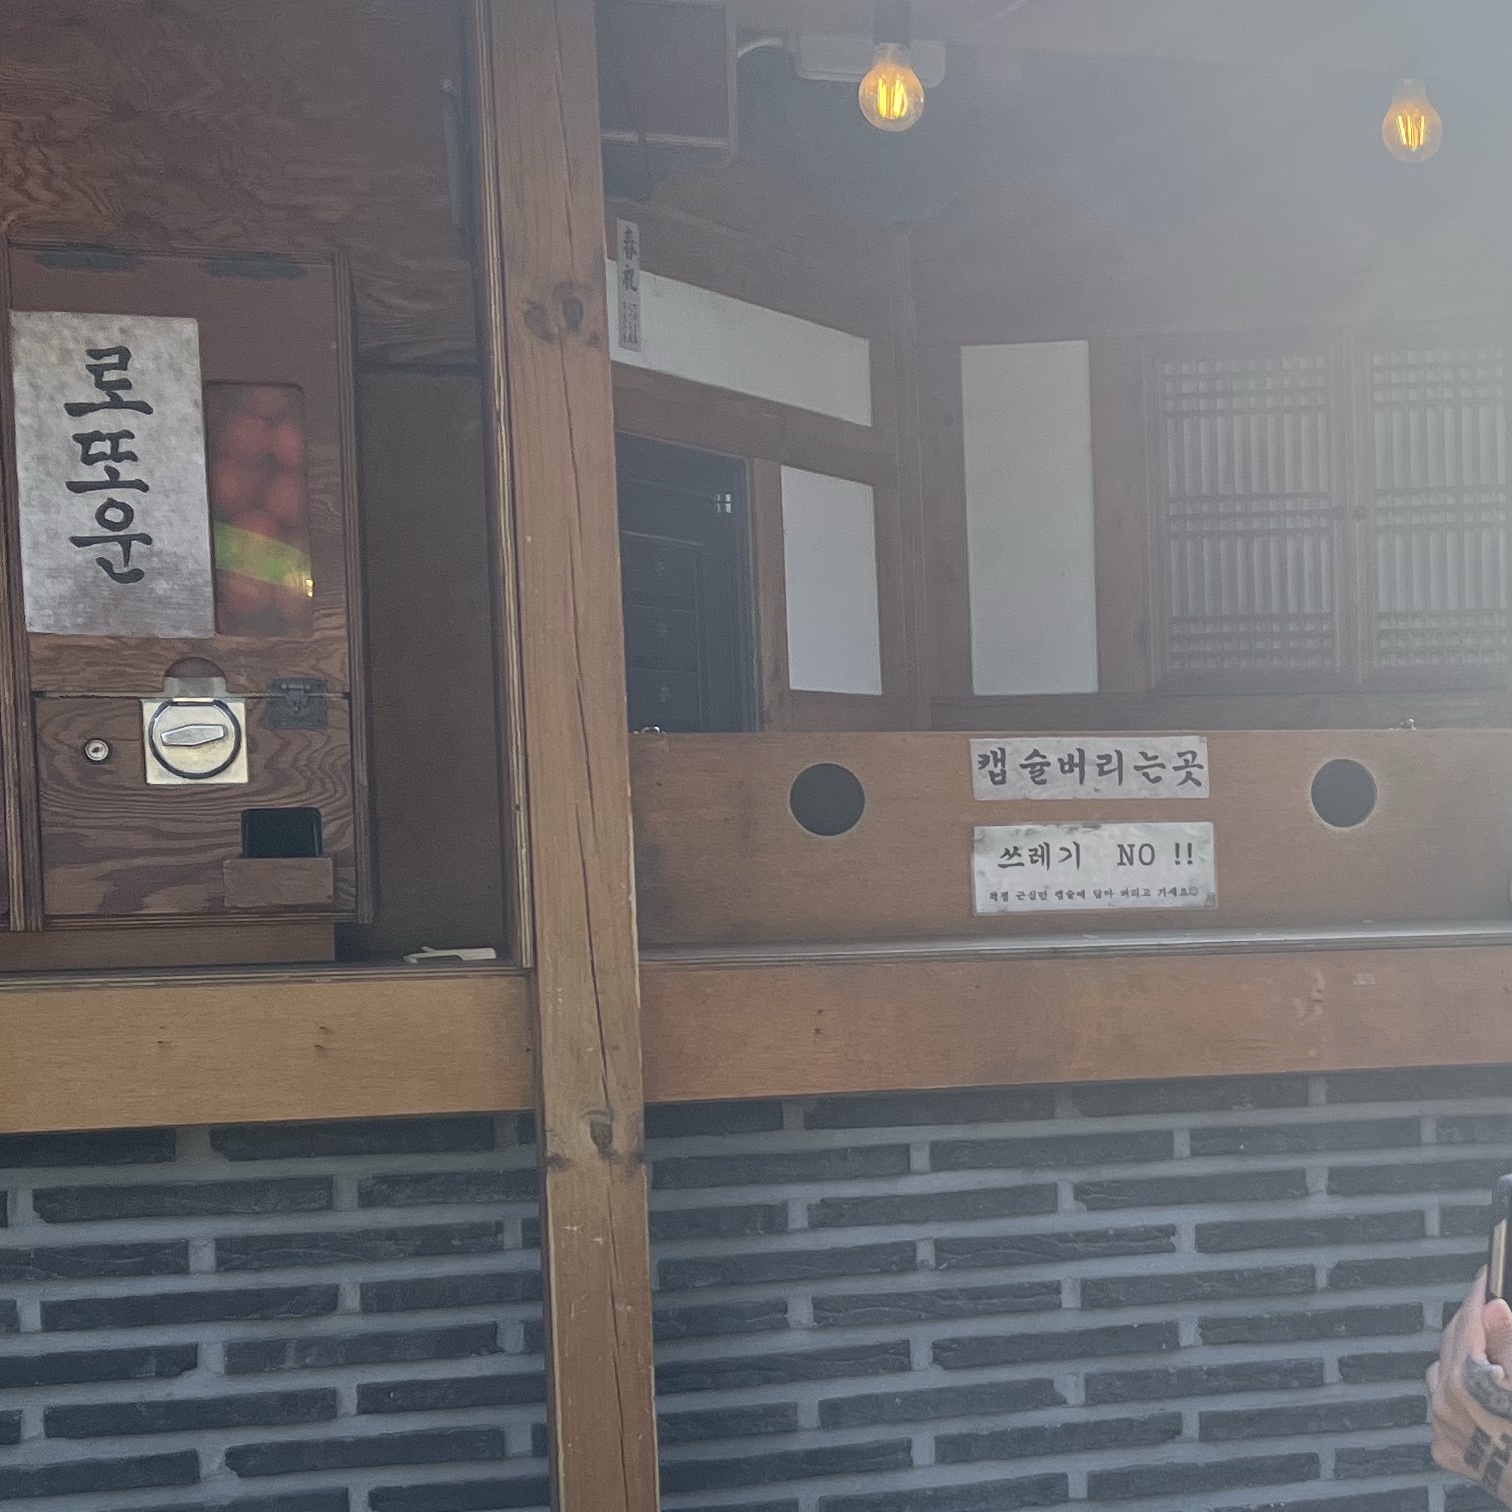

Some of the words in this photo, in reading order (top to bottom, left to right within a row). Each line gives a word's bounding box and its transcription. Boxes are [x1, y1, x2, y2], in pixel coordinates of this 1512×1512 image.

[64, 345, 154, 585] 로또운
[977, 746, 1204, 787] 캡슐버리는곳
[997, 841, 1082, 871] 쓰레기
[1116, 843, 1156, 866] NO
[1174, 842, 1194, 865] !!
